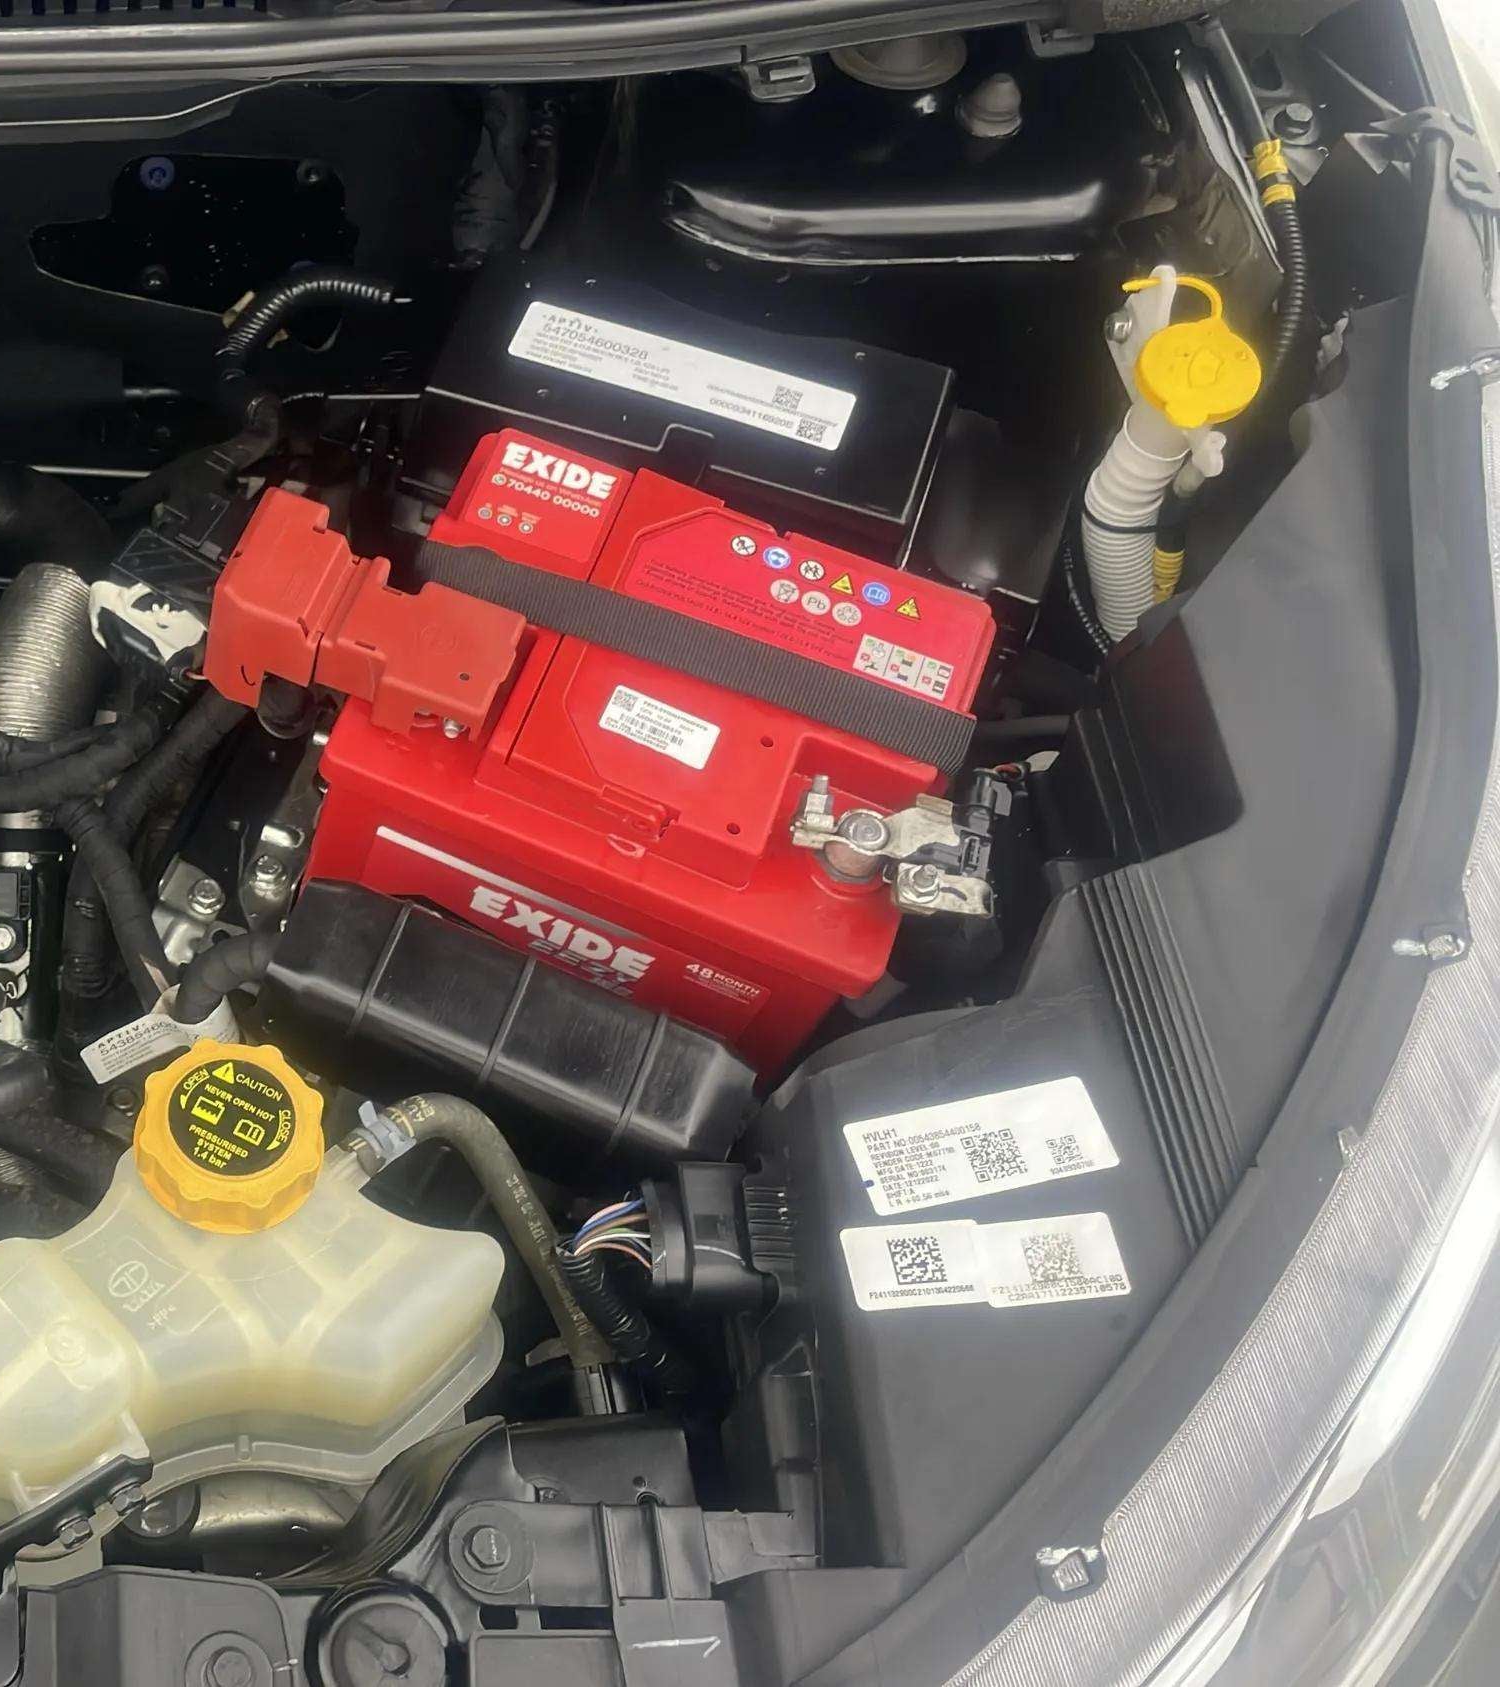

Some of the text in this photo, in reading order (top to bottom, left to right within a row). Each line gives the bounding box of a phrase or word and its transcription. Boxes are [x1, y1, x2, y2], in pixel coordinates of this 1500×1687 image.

[501, 441, 618, 500] EXIDE
[506, 478, 551, 501] 70440
[552, 495, 600, 518] 00000
[470, 885, 656, 980] EXIDE
[685, 963, 714, 979] 48
[713, 973, 760, 995] MONTH
[183, 1068, 209, 1091] OPEN
[236, 1073, 283, 1102] CAUTION
[204, 1083, 276, 1122] NEVER OPEN HOT
[189, 1124, 249, 1158] PRESSURISED
[278, 1109, 292, 1143] CLOSE
[193, 1147, 227, 1169] 1.4 bar
[197, 1138, 232, 1160] SYSTEM
[867, 1141, 891, 1153] PART
